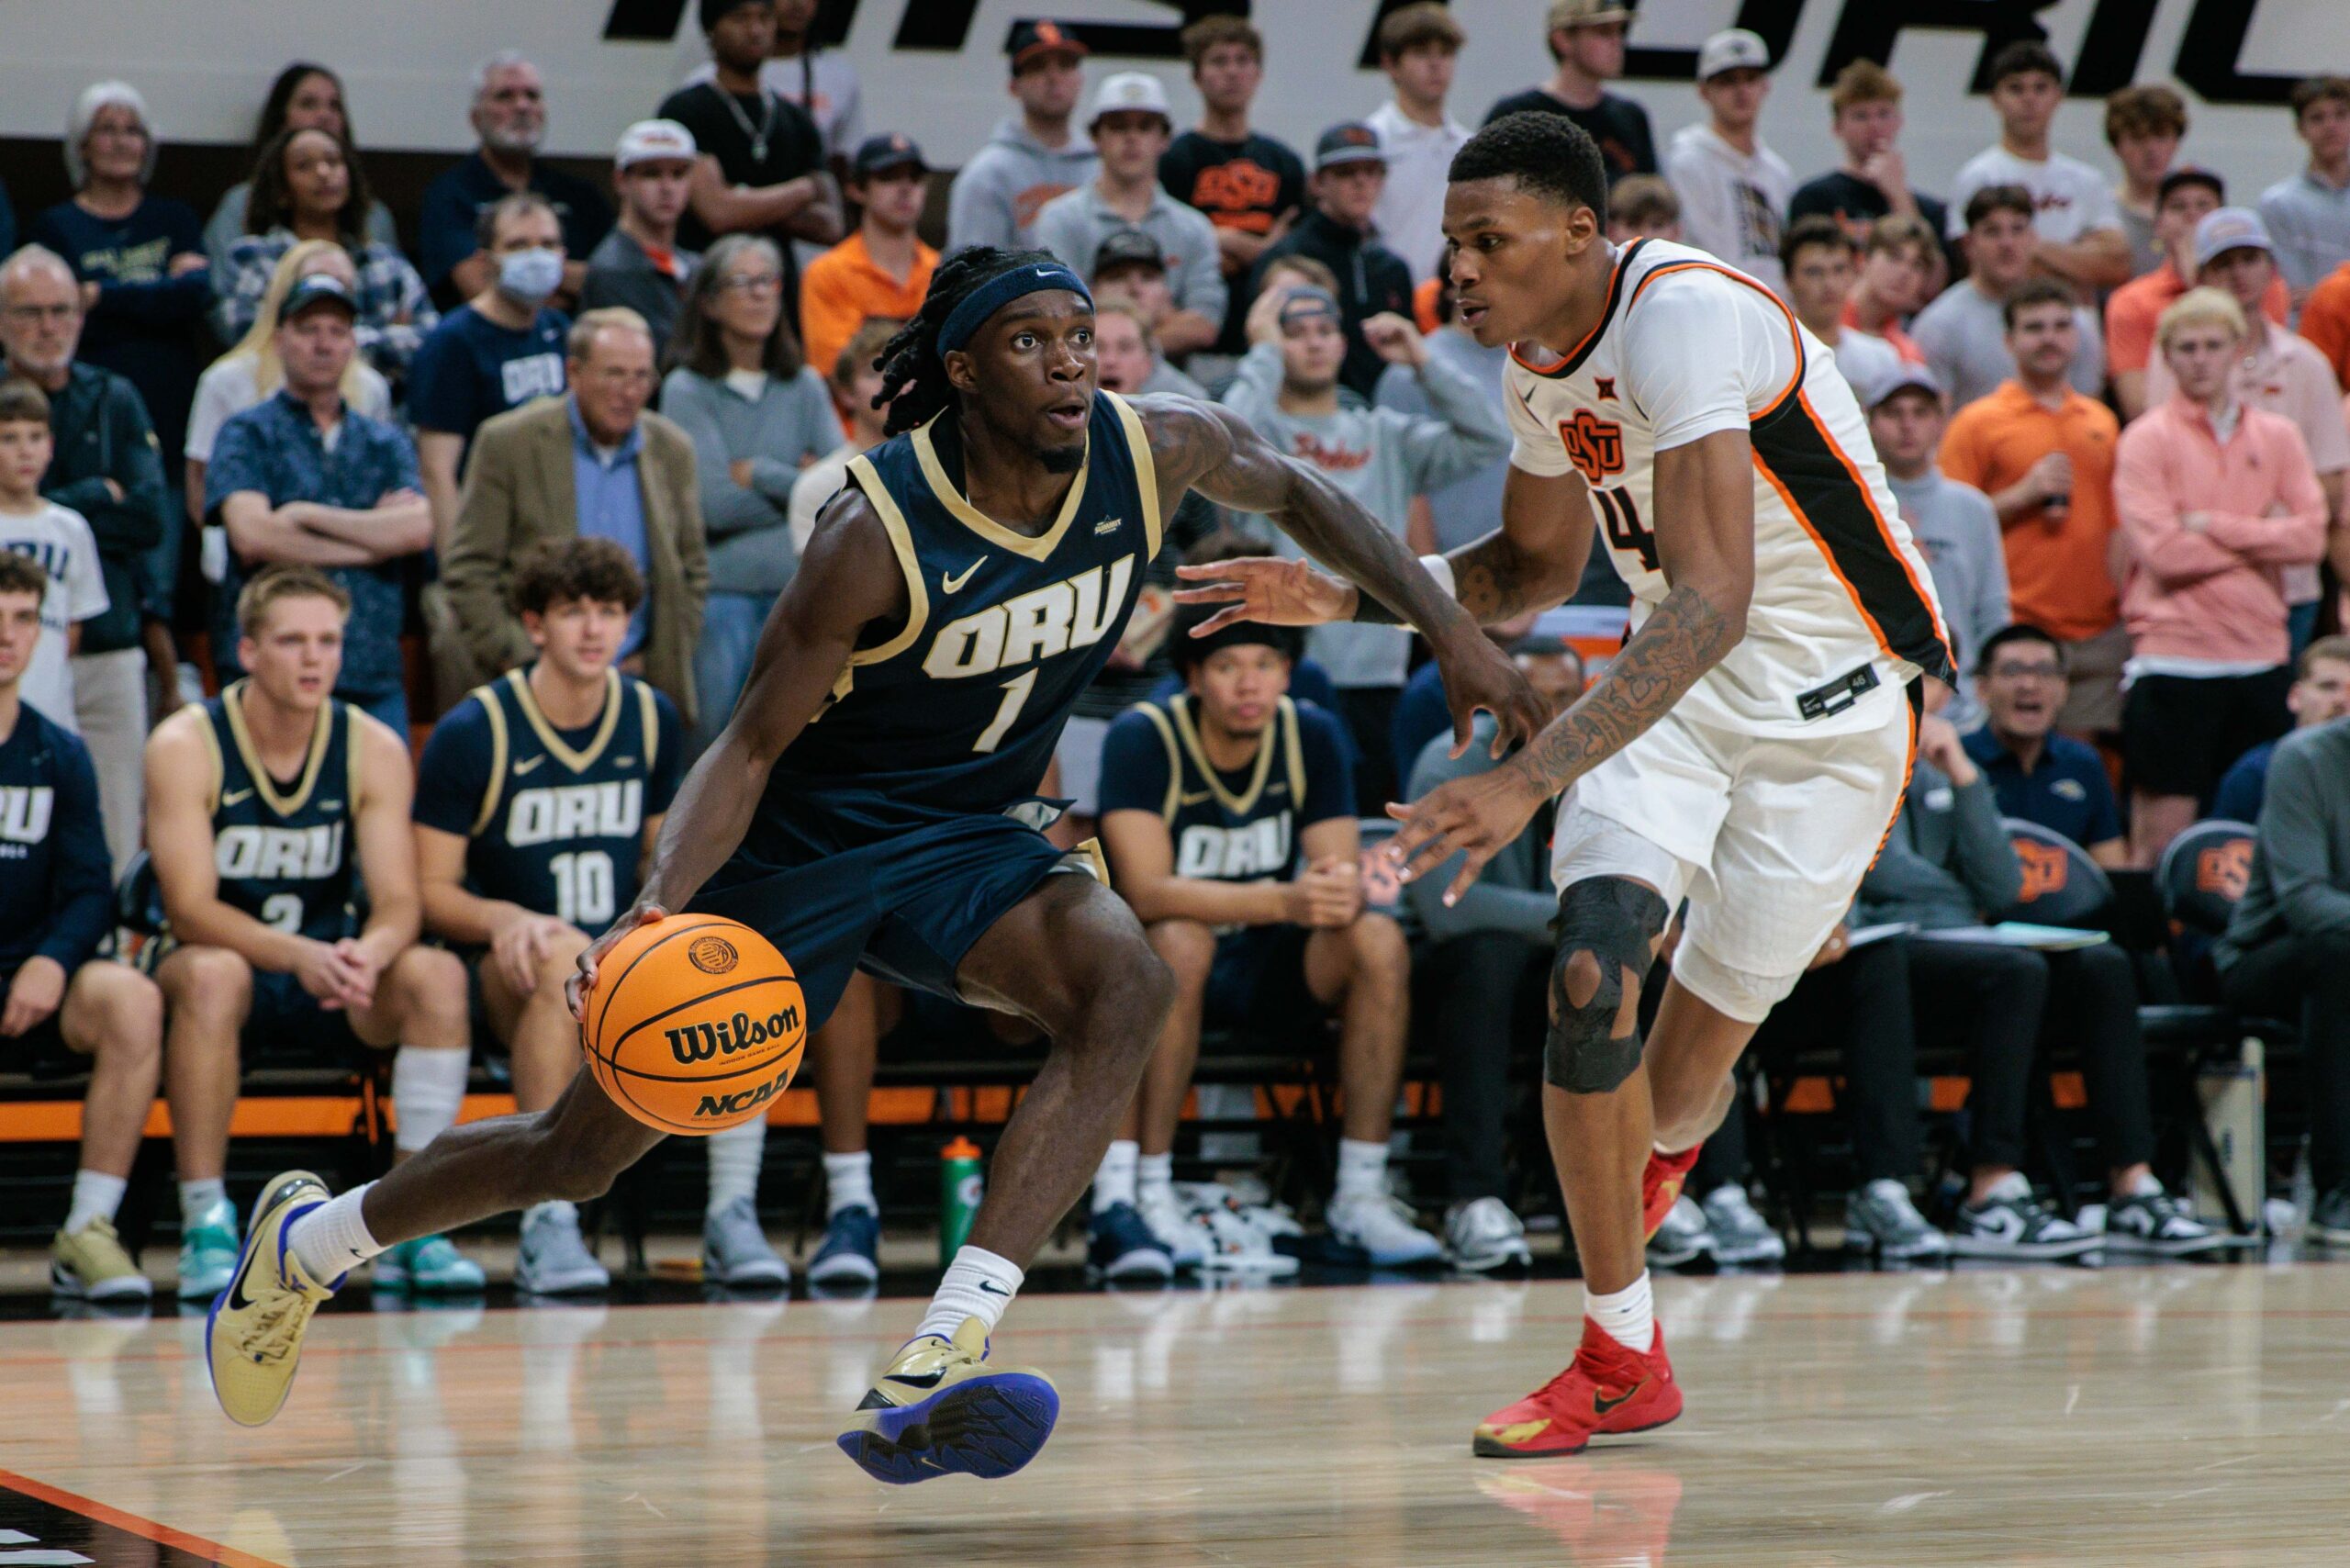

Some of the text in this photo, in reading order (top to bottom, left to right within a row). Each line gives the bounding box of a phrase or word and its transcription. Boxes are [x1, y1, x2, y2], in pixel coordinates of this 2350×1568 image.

[1559, 408, 1625, 486] OSU
[1592, 485, 1661, 573] 4
[921, 553, 1136, 679] ORU
[971, 666, 1039, 754] 1
[506, 778, 643, 848] ORU
[1177, 808, 1292, 878] ORU
[216, 820, 344, 879] ORU
[549, 850, 615, 924] 10
[664, 1003, 800, 1065] Wilson
[693, 1068, 789, 1117] NCAA
